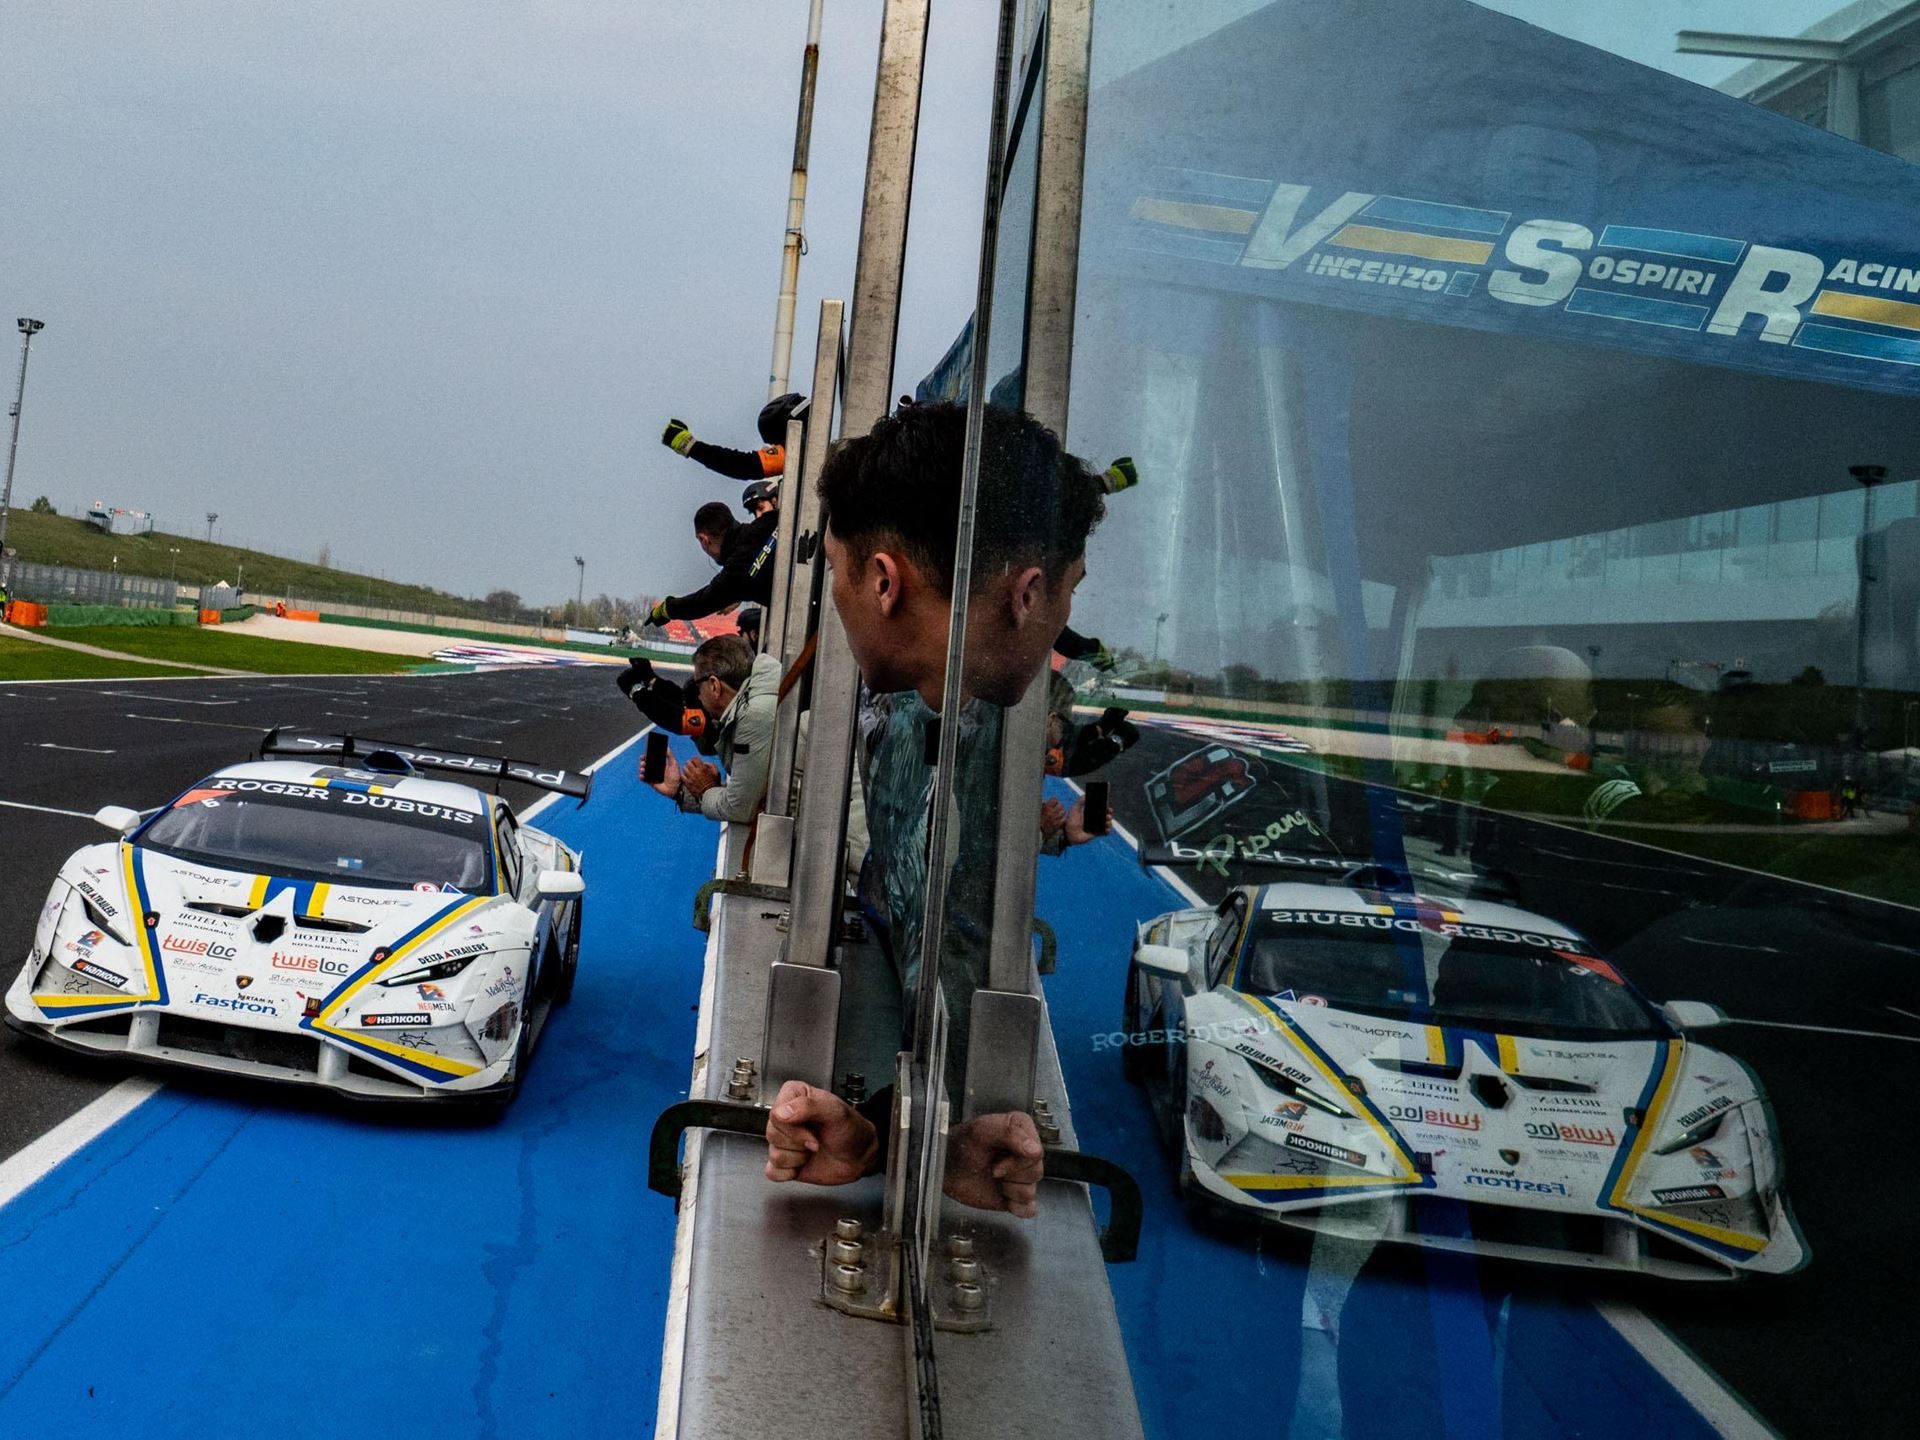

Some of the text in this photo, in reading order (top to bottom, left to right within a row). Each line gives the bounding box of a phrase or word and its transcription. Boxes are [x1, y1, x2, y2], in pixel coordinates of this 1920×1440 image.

[1240, 182, 1447, 294] VINCENZO
[1487, 218, 1716, 307] SOSPIRI
[212, 779, 474, 825] ROGER DUBUIS
[170, 868, 229, 886] ASTONJET
[338, 894, 399, 906] ASTONJET
[178, 913, 218, 926] HOTEL
[294, 933, 337, 943] HOTEL
[418, 943, 489, 965] DELTA TRAILERS
[194, 993, 277, 1016] Fastron
[1089, 1028, 1188, 1053] ROGER
